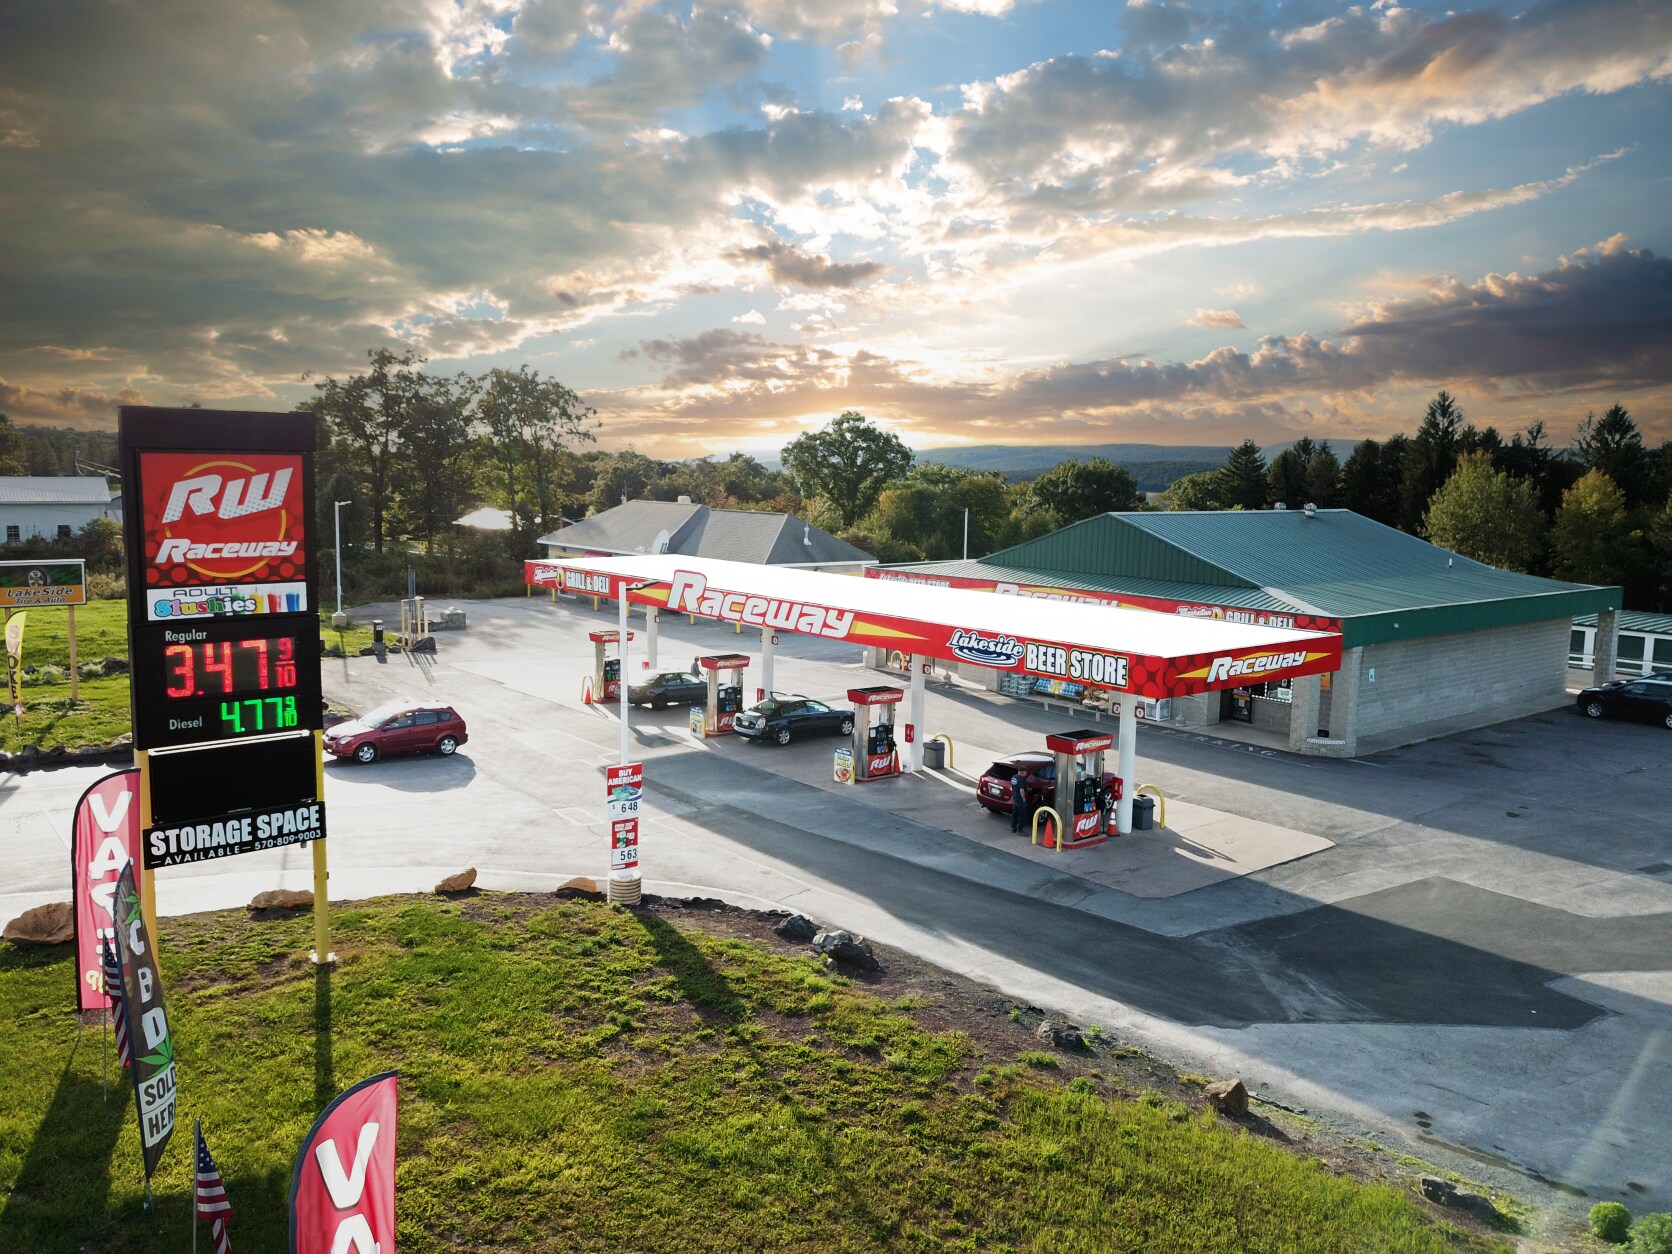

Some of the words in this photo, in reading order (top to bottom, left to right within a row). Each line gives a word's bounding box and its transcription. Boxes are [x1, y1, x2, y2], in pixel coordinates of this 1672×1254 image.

[161, 467, 294, 524] RW
[154, 538, 298, 564] Raceway
[6, 587, 74, 598] LakeSide
[173, 587, 238, 598] ADULT
[566, 569, 586, 590] GRILL
[593, 574, 610, 594] DELI
[15, 597, 35, 605] Tire
[154, 596, 257, 618] Slushies
[666, 569, 855, 639] Raceway
[165, 629, 207, 643] Regular
[165, 638, 269, 699] 3.47
[946, 628, 1025, 657] Lakeside
[1025, 641, 1068, 677] BEER
[1069, 649, 1128, 688] STORE
[1207, 650, 1307, 683] Raceway
[169, 716, 203, 731] Diesel
[220, 697, 284, 733] 4.77
[1074, 737, 1112, 752] Raceway
[607, 773, 642, 786] AMERICAN
[618, 768, 633, 777] BUY
[150, 817, 253, 856] STORAGE
[256, 804, 320, 839] SPACE
[1075, 813, 1099, 833] RW
[164, 845, 240, 865] AVAILABLE
[128, 919, 167, 1051] CBD
[144, 1066, 176, 1106] SOLD
